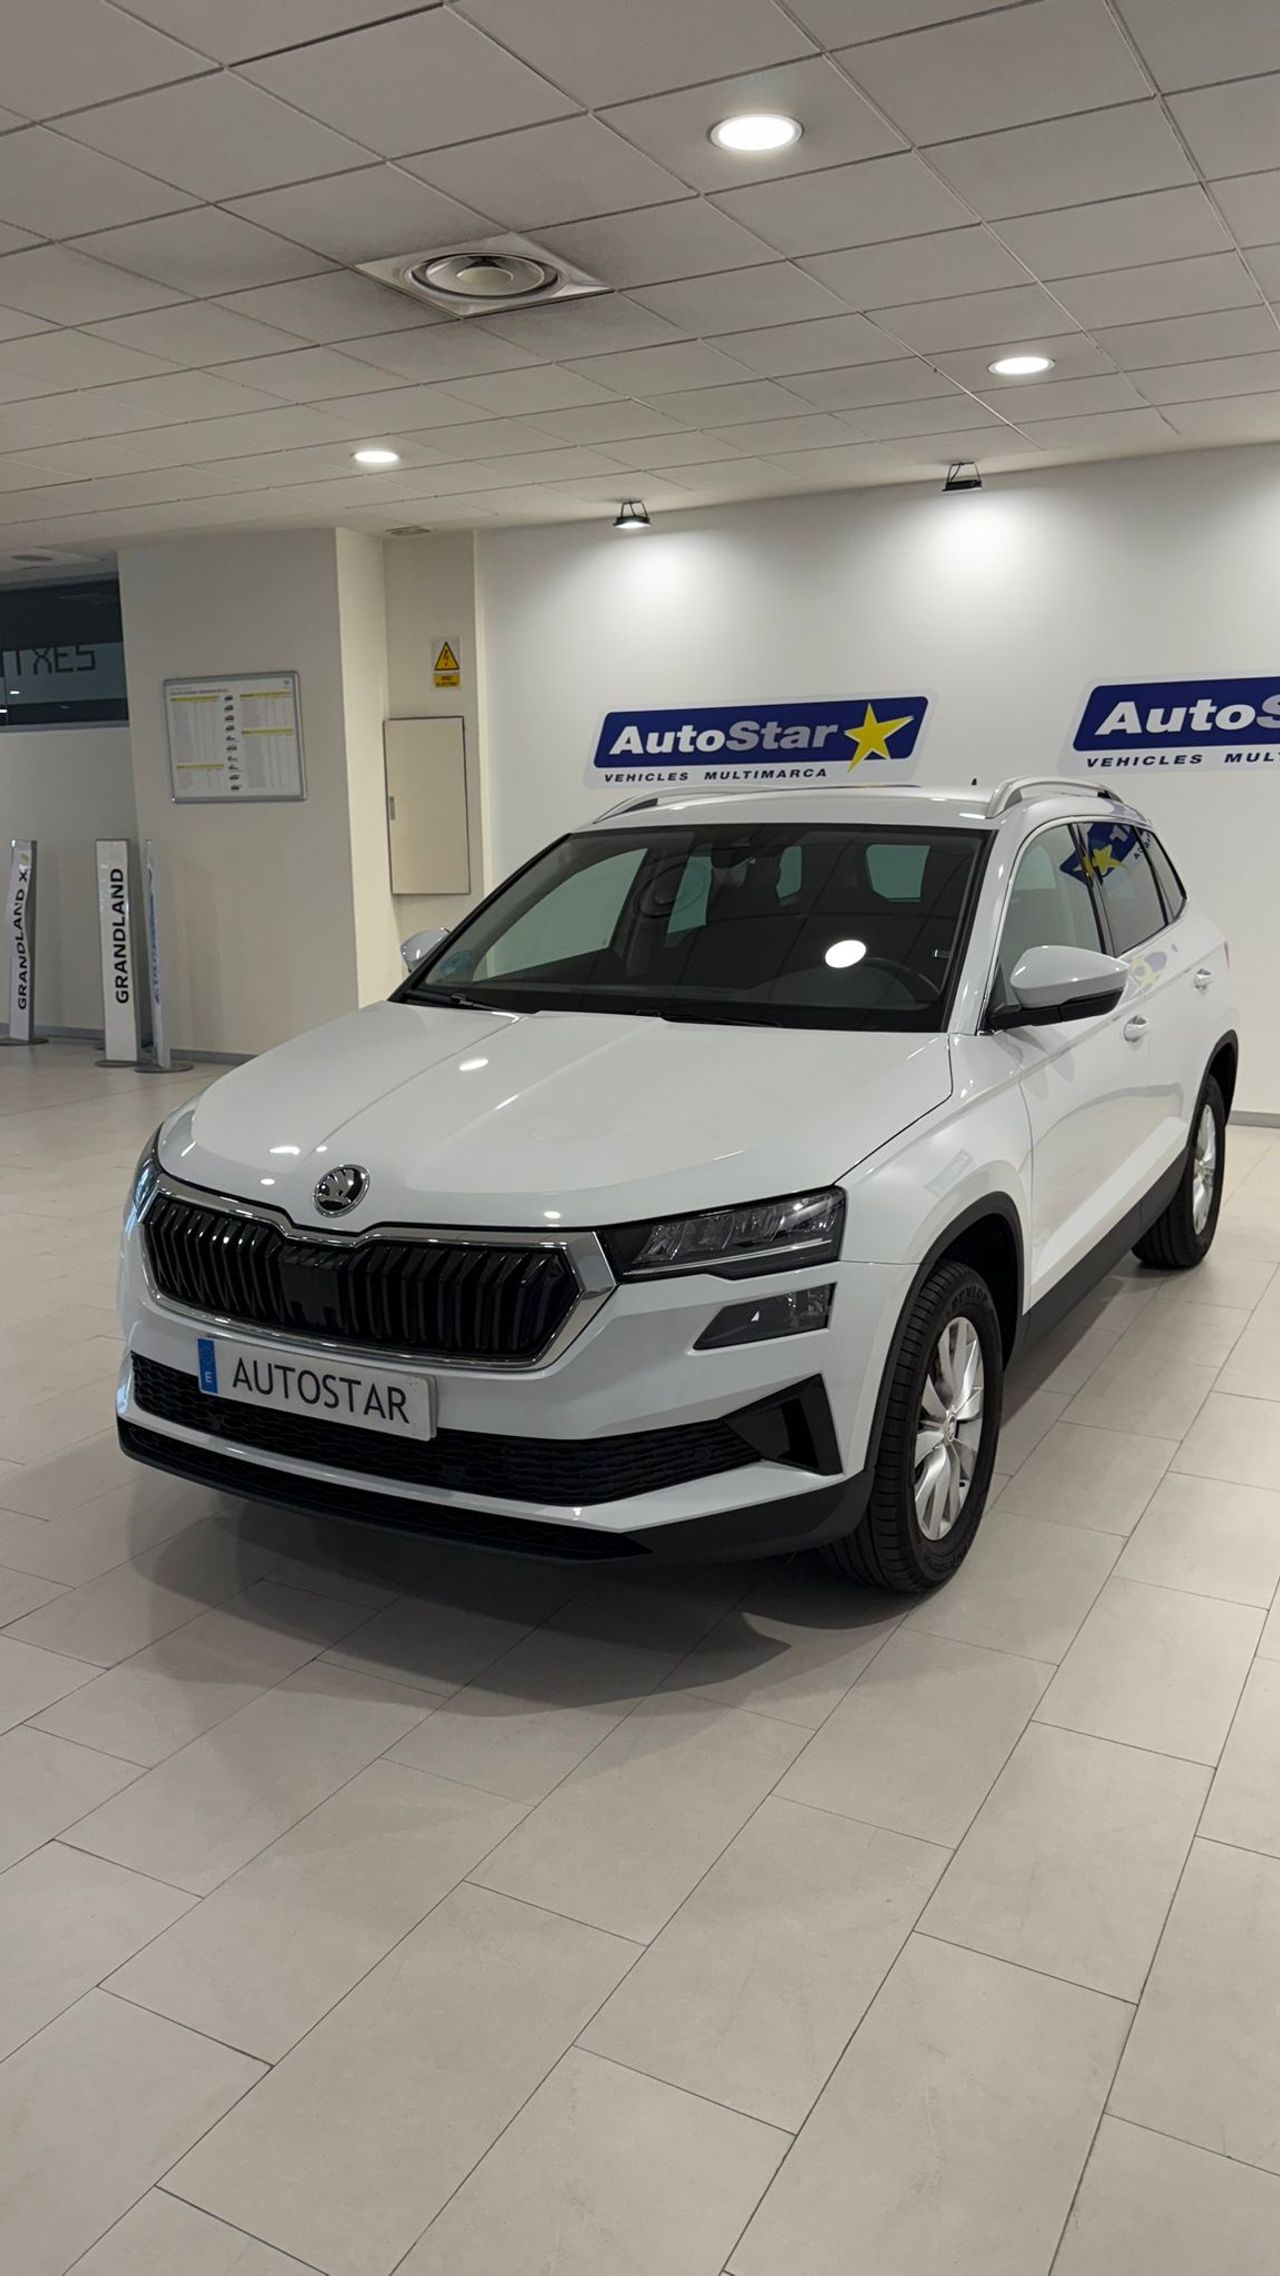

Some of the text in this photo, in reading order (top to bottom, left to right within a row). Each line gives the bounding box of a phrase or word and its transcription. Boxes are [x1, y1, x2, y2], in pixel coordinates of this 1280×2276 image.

[0, 643, 96, 676] TXES
[609, 720, 838, 755] AutoStar
[604, 768, 827, 782] VEHICLES MULTIMARCA
[1087, 750, 1280, 768] VEHICLES MUL
[13, 869, 28, 1010] GRANDLAND X
[110, 868, 129, 1004] GRANDLAND
[205, 1371, 212, 1384] E
[232, 1357, 409, 1424] AUTOSTAR
